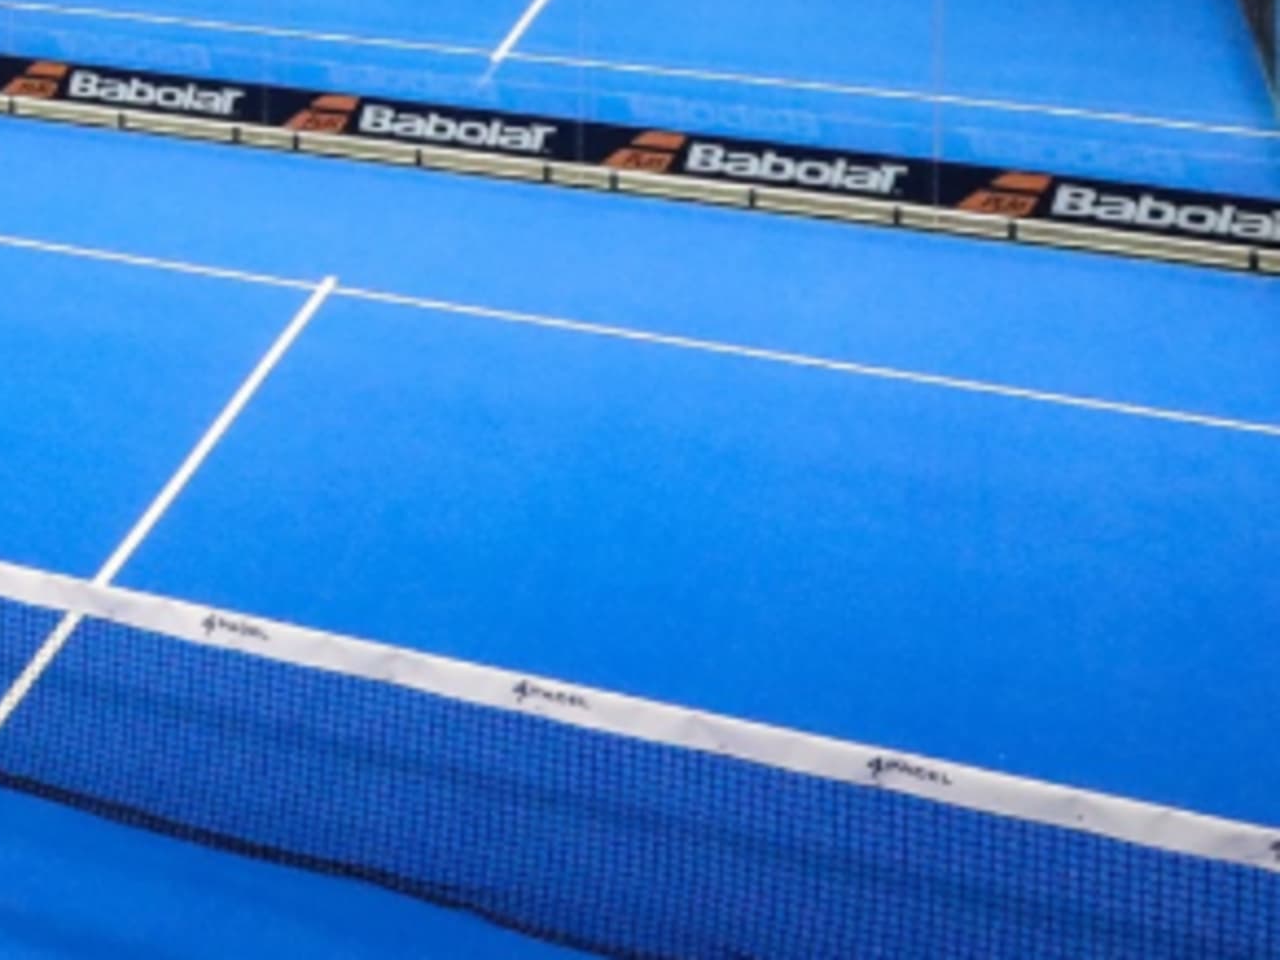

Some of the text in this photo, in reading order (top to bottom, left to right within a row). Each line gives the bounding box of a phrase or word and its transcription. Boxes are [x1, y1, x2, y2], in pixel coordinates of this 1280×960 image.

[69, 70, 245, 115] Babolat
[358, 104, 557, 153] Babolat
[686, 143, 907, 194] Babolat
